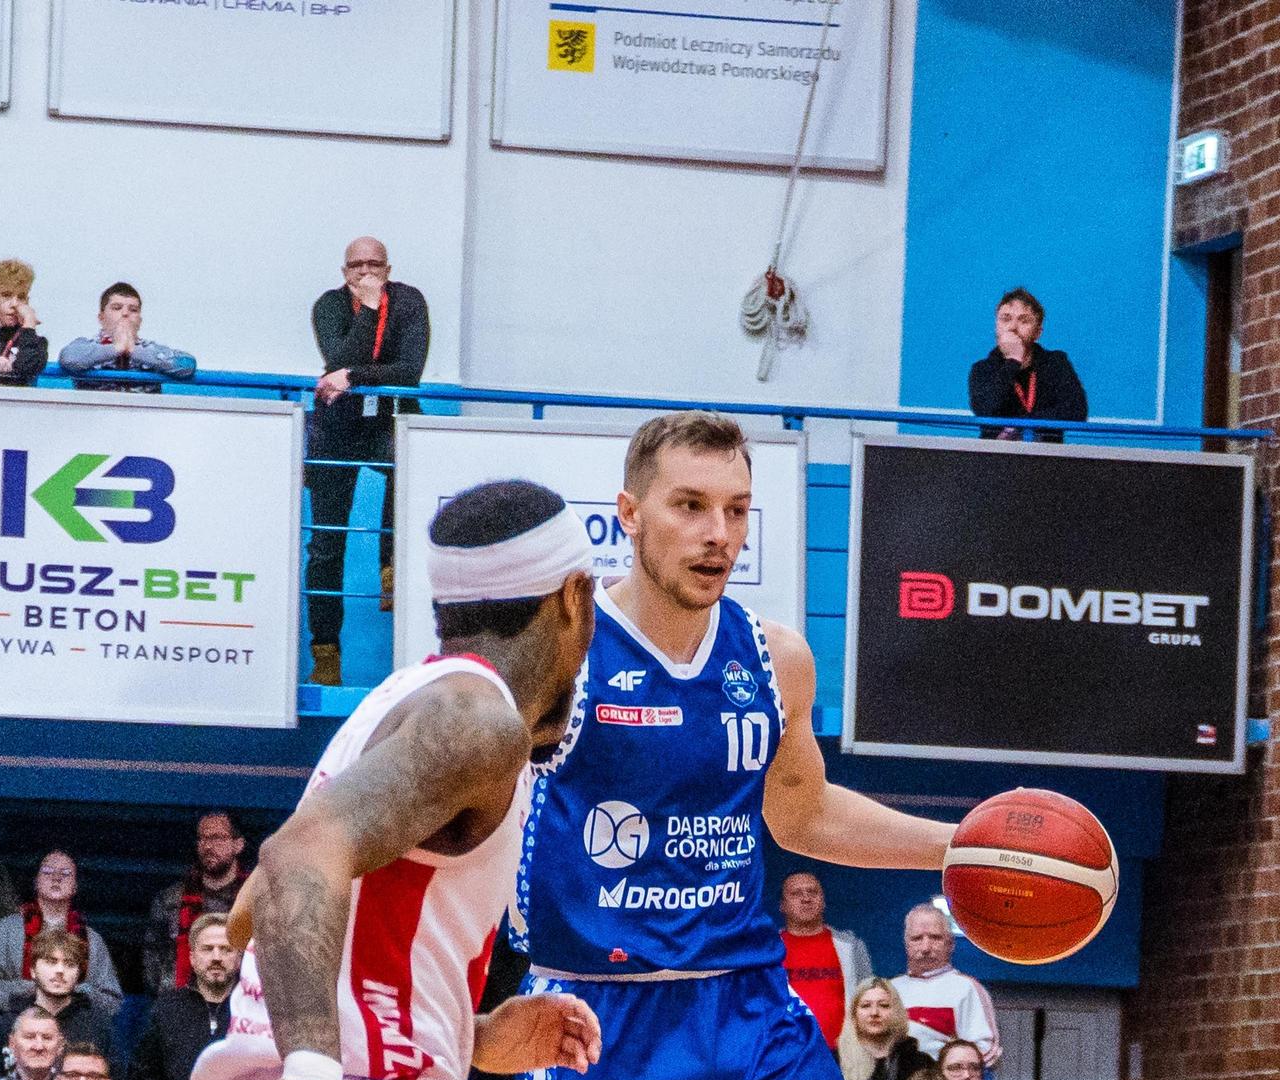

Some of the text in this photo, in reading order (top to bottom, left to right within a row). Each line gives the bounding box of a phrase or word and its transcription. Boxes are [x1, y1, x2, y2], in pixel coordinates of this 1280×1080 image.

[223, 0, 296, 13] CHEMIA
[310, 2, 351, 15] BHP
[613, 32, 677, 50] Podmiot
[682, 36, 753, 58] Leczniczy
[612, 54, 716, 77] Województwa
[966, 582, 1210, 628] DOMBET
[23, 604, 146, 632] BETON
[1147, 632, 1202, 648] GRUPA
[100, 642, 255, 665] TRANSPORT
[599, 707, 639, 722] ORLEN
[720, 712, 770, 772] 10
[666, 813, 751, 839] DĄBROWA
[704, 859, 720, 872] dla
[624, 880, 746, 910] DROGOPOL
